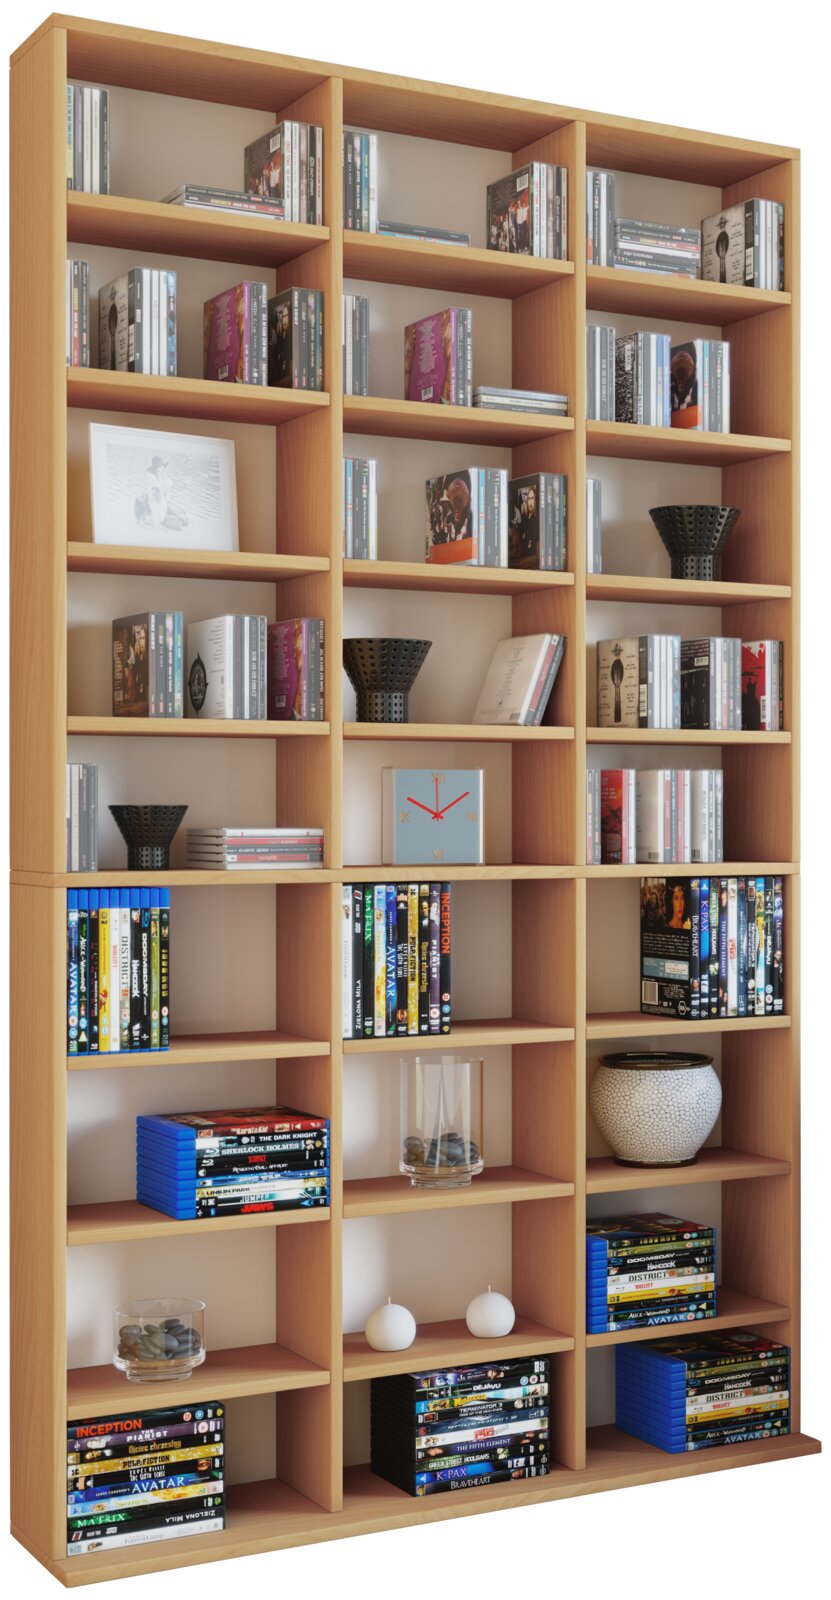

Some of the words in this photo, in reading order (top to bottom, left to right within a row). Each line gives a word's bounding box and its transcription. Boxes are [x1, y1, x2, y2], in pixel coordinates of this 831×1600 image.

[441, 892, 450, 954] INCEPTION
[387, 946, 395, 998] AVATAR
[132, 960, 140, 999] HANCOCK
[122, 988, 128, 997] 9
[222, 1147, 265, 1155] SHERLOCK
[266, 1143, 299, 1152] HOLMES
[240, 1193, 276, 1202] JUMPER
[241, 1202, 274, 1213] JAWS
[627, 1253, 676, 1264] DOOMSDAY
[647, 1261, 676, 1270] HANCOCK
[628, 1271, 666, 1282] DISTRICT
[647, 1315, 686, 1325] AVATAR
[705, 1373, 751, 1384] DOOMSDAY
[724, 1380, 751, 1390] HANCOCK
[706, 1391, 744, 1402] DISTRICT
[460, 1404, 497, 1412] TERMINATOR
[76, 1419, 143, 1438] INCEPTION
[126, 1430, 168, 1442] PIANIST
[724, 1433, 761, 1443] AVATAR
[123, 1459, 141, 1468] PULP
[142, 1455, 170, 1466] FICTION
[464, 1453, 489, 1462] HOOLIGANS
[436, 1467, 467, 1481] K-PAX
[132, 1476, 186, 1494] AVATAR
[451, 1476, 491, 1489] BRAVEHEART
[77, 1513, 127, 1528] MATRIX
[186, 1510, 215, 1520] ZIELONA
